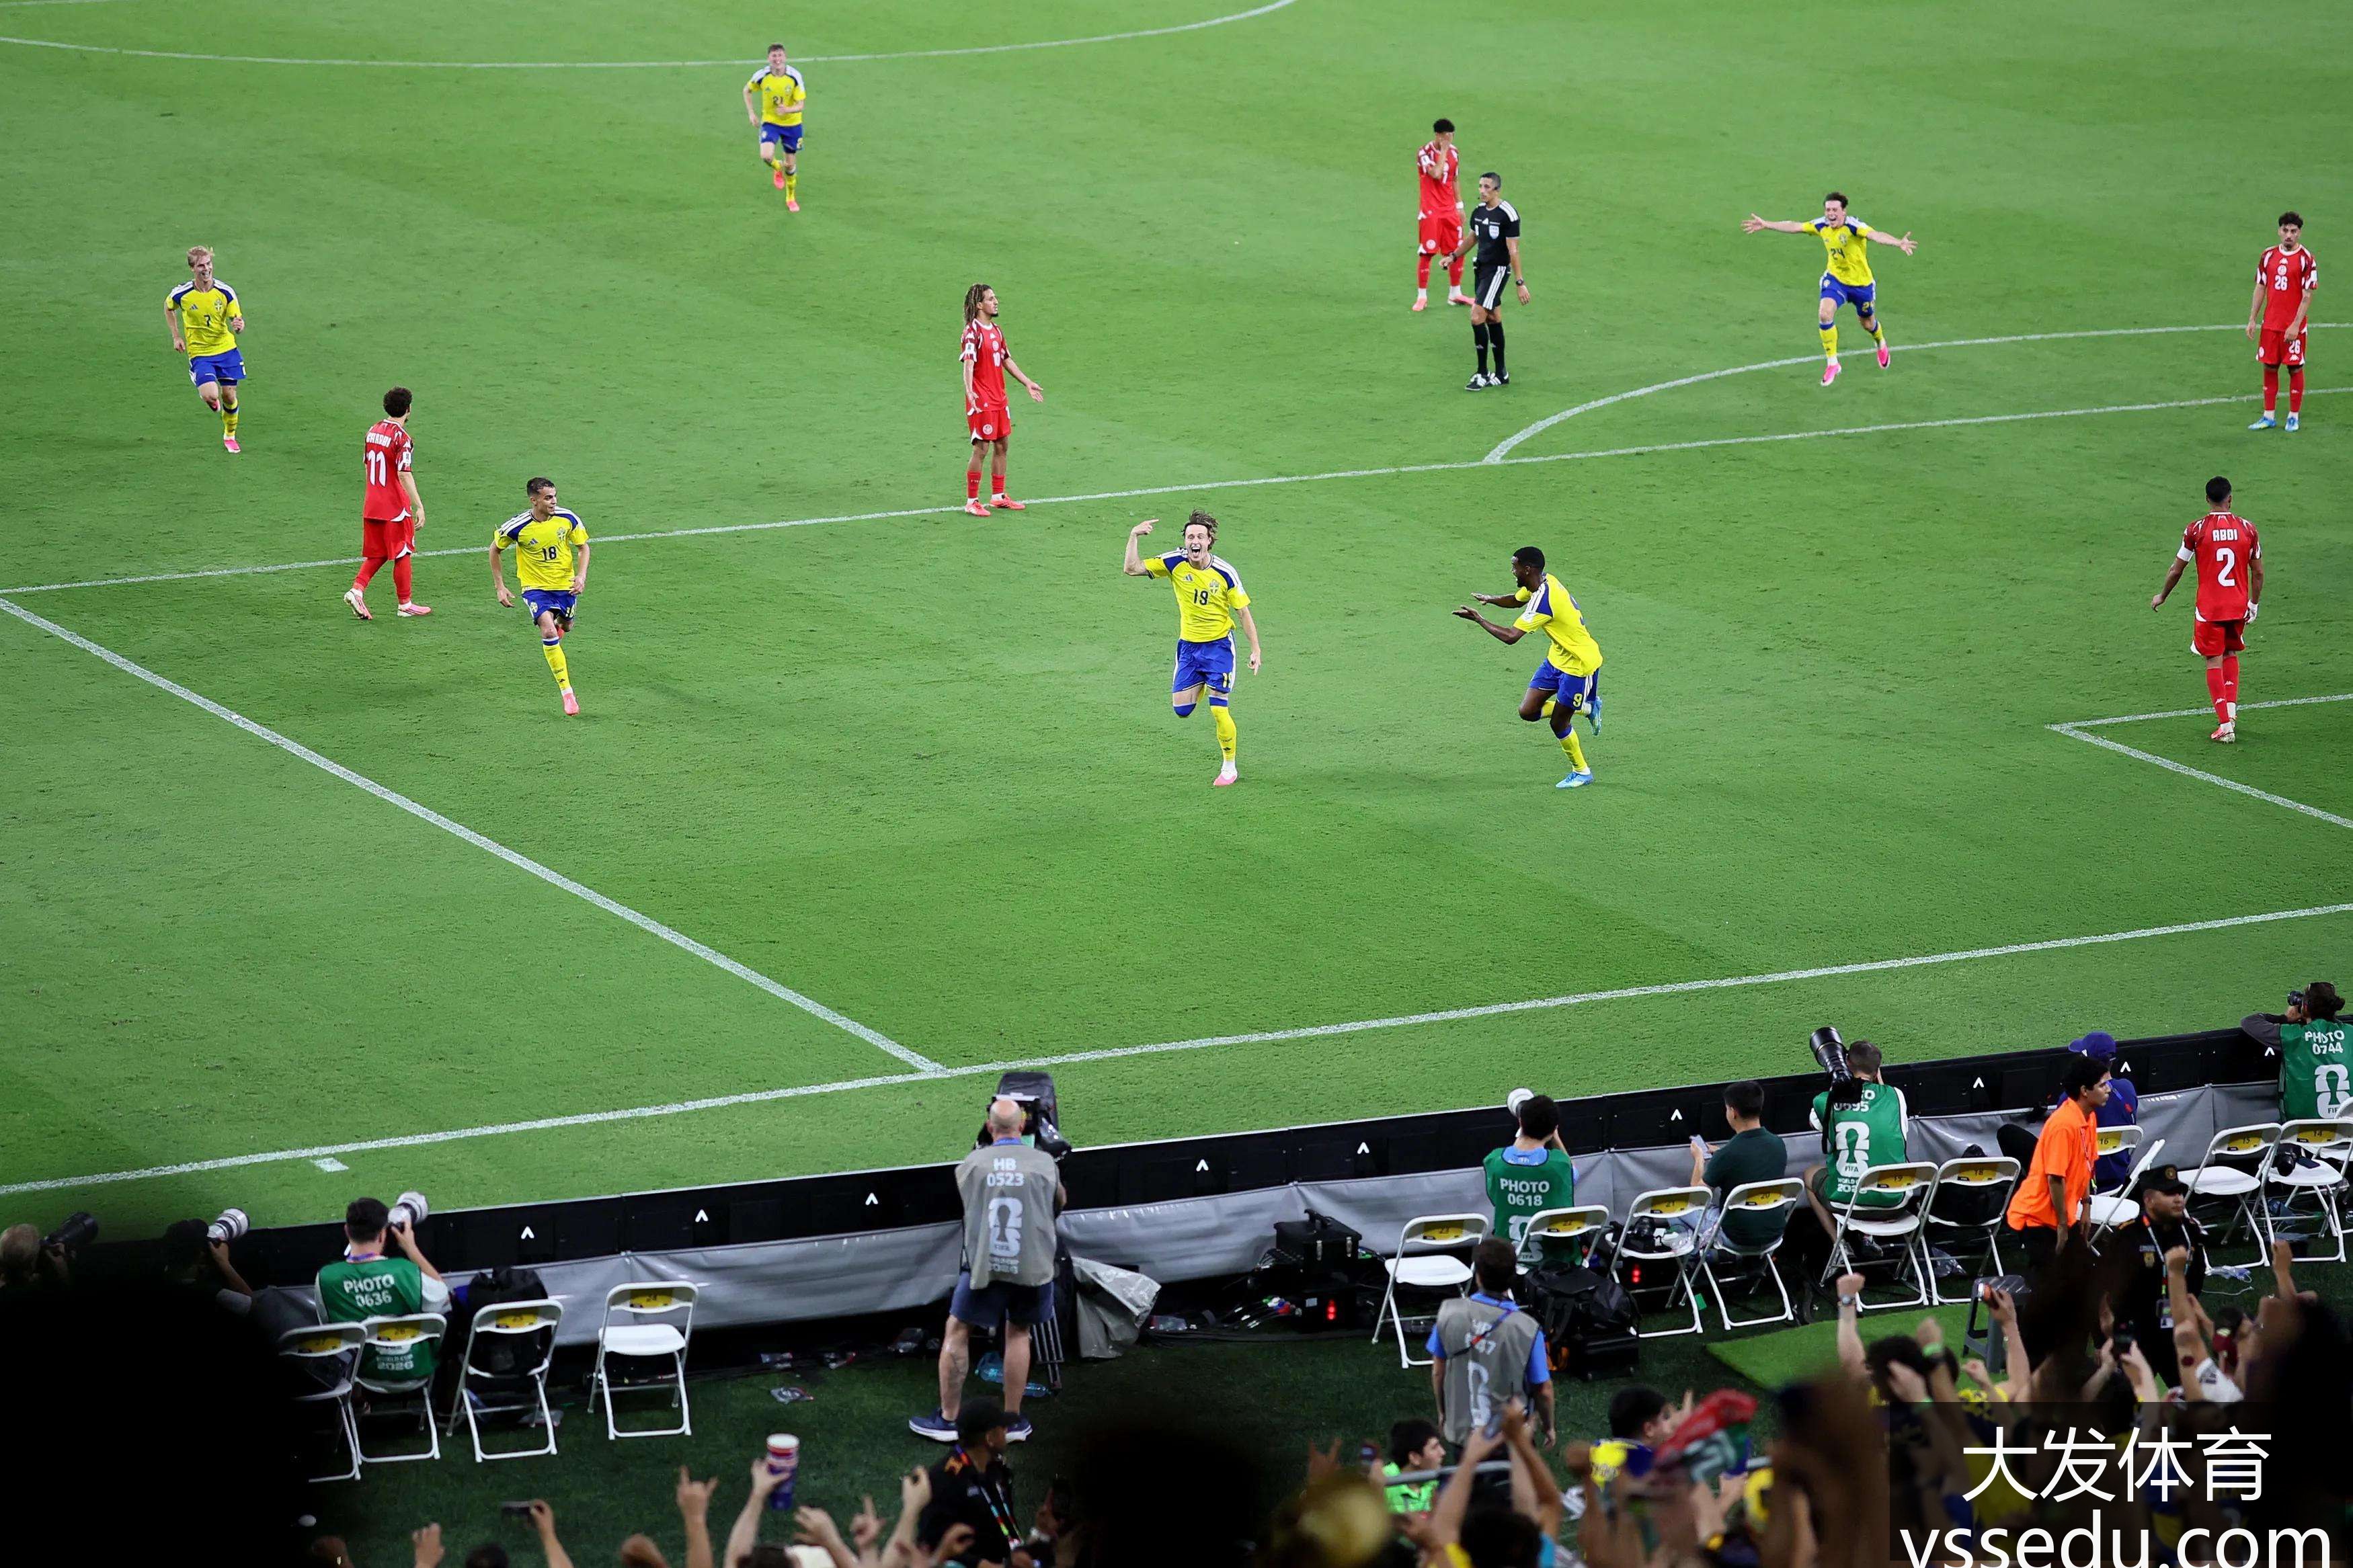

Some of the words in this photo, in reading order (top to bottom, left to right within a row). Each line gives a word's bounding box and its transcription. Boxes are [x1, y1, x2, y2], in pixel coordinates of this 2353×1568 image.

[1831, 248, 1845, 259] 24
[2274, 275, 2287, 290] 26
[204, 315, 211, 327] 7
[2288, 339, 2301, 354] 26
[368, 450, 387, 487] 11
[2212, 529, 2237, 542] ABDI
[542, 546, 557, 562] 18
[2216, 548, 2235, 587] 2
[1194, 589, 1208, 606] 19
[1573, 693, 1583, 707] 9
[2305, 1030, 2345, 1044] PHOTO
[2312, 1042, 2344, 1055] 0744
[993, 1157, 1016, 1171] HB
[986, 1172, 1025, 1187] 0523
[1499, 1178, 1550, 1194] PHOTO
[1507, 1193, 1543, 1207] 0618
[344, 1274, 395, 1294] PHOTO
[355, 1291, 392, 1308] 0636
